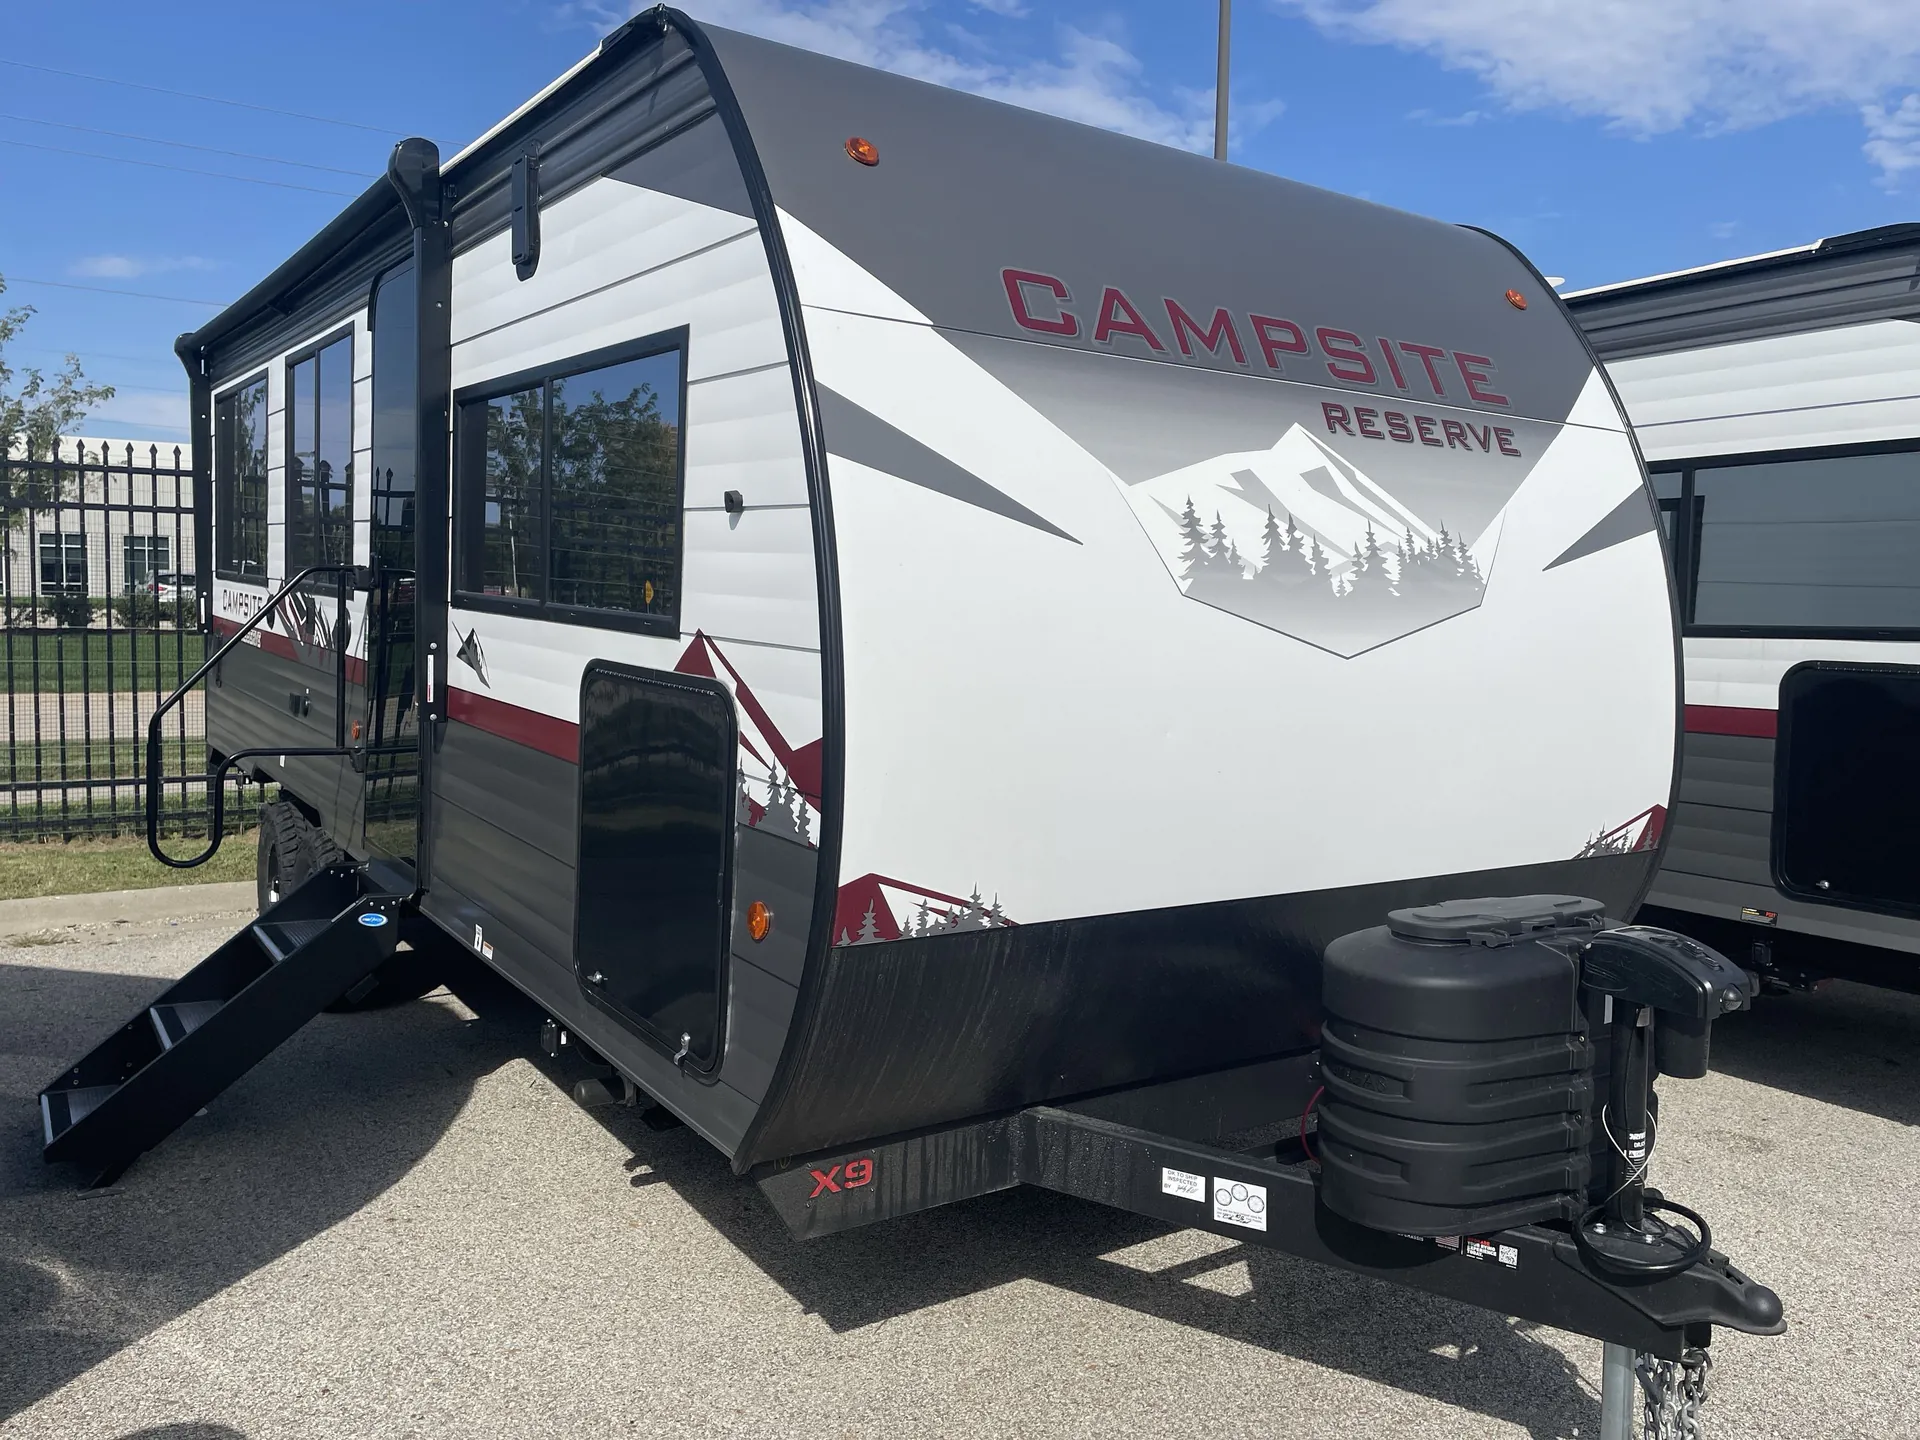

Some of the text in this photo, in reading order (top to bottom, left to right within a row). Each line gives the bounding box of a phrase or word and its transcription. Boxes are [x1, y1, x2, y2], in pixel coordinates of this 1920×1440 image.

[1001, 267, 1510, 406] CAMPSITE
[1321, 401, 1522, 457] RESERVE
[809, 1158, 873, 1198] X9
[1167, 1175, 1198, 1187] INSPECTED
